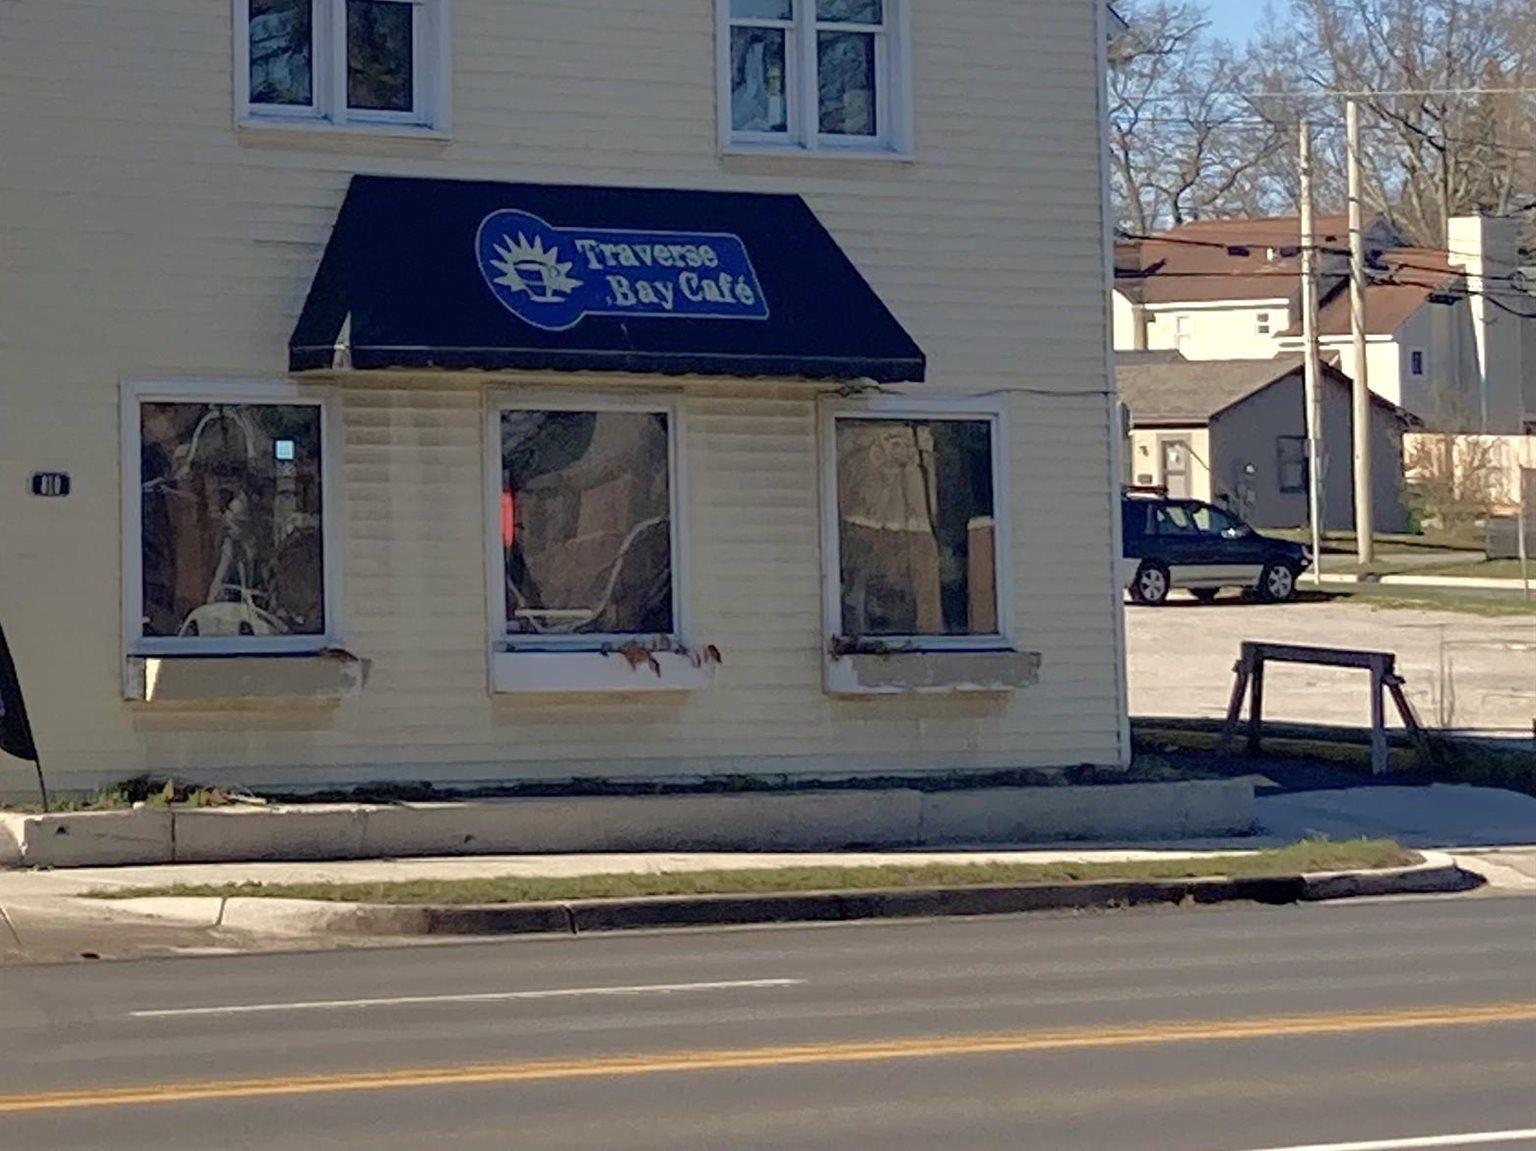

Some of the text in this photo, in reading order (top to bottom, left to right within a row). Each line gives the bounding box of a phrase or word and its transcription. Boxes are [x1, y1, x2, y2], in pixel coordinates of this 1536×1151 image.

[574, 239, 718, 269] Traverse
[606, 270, 755, 310] Bay Café
